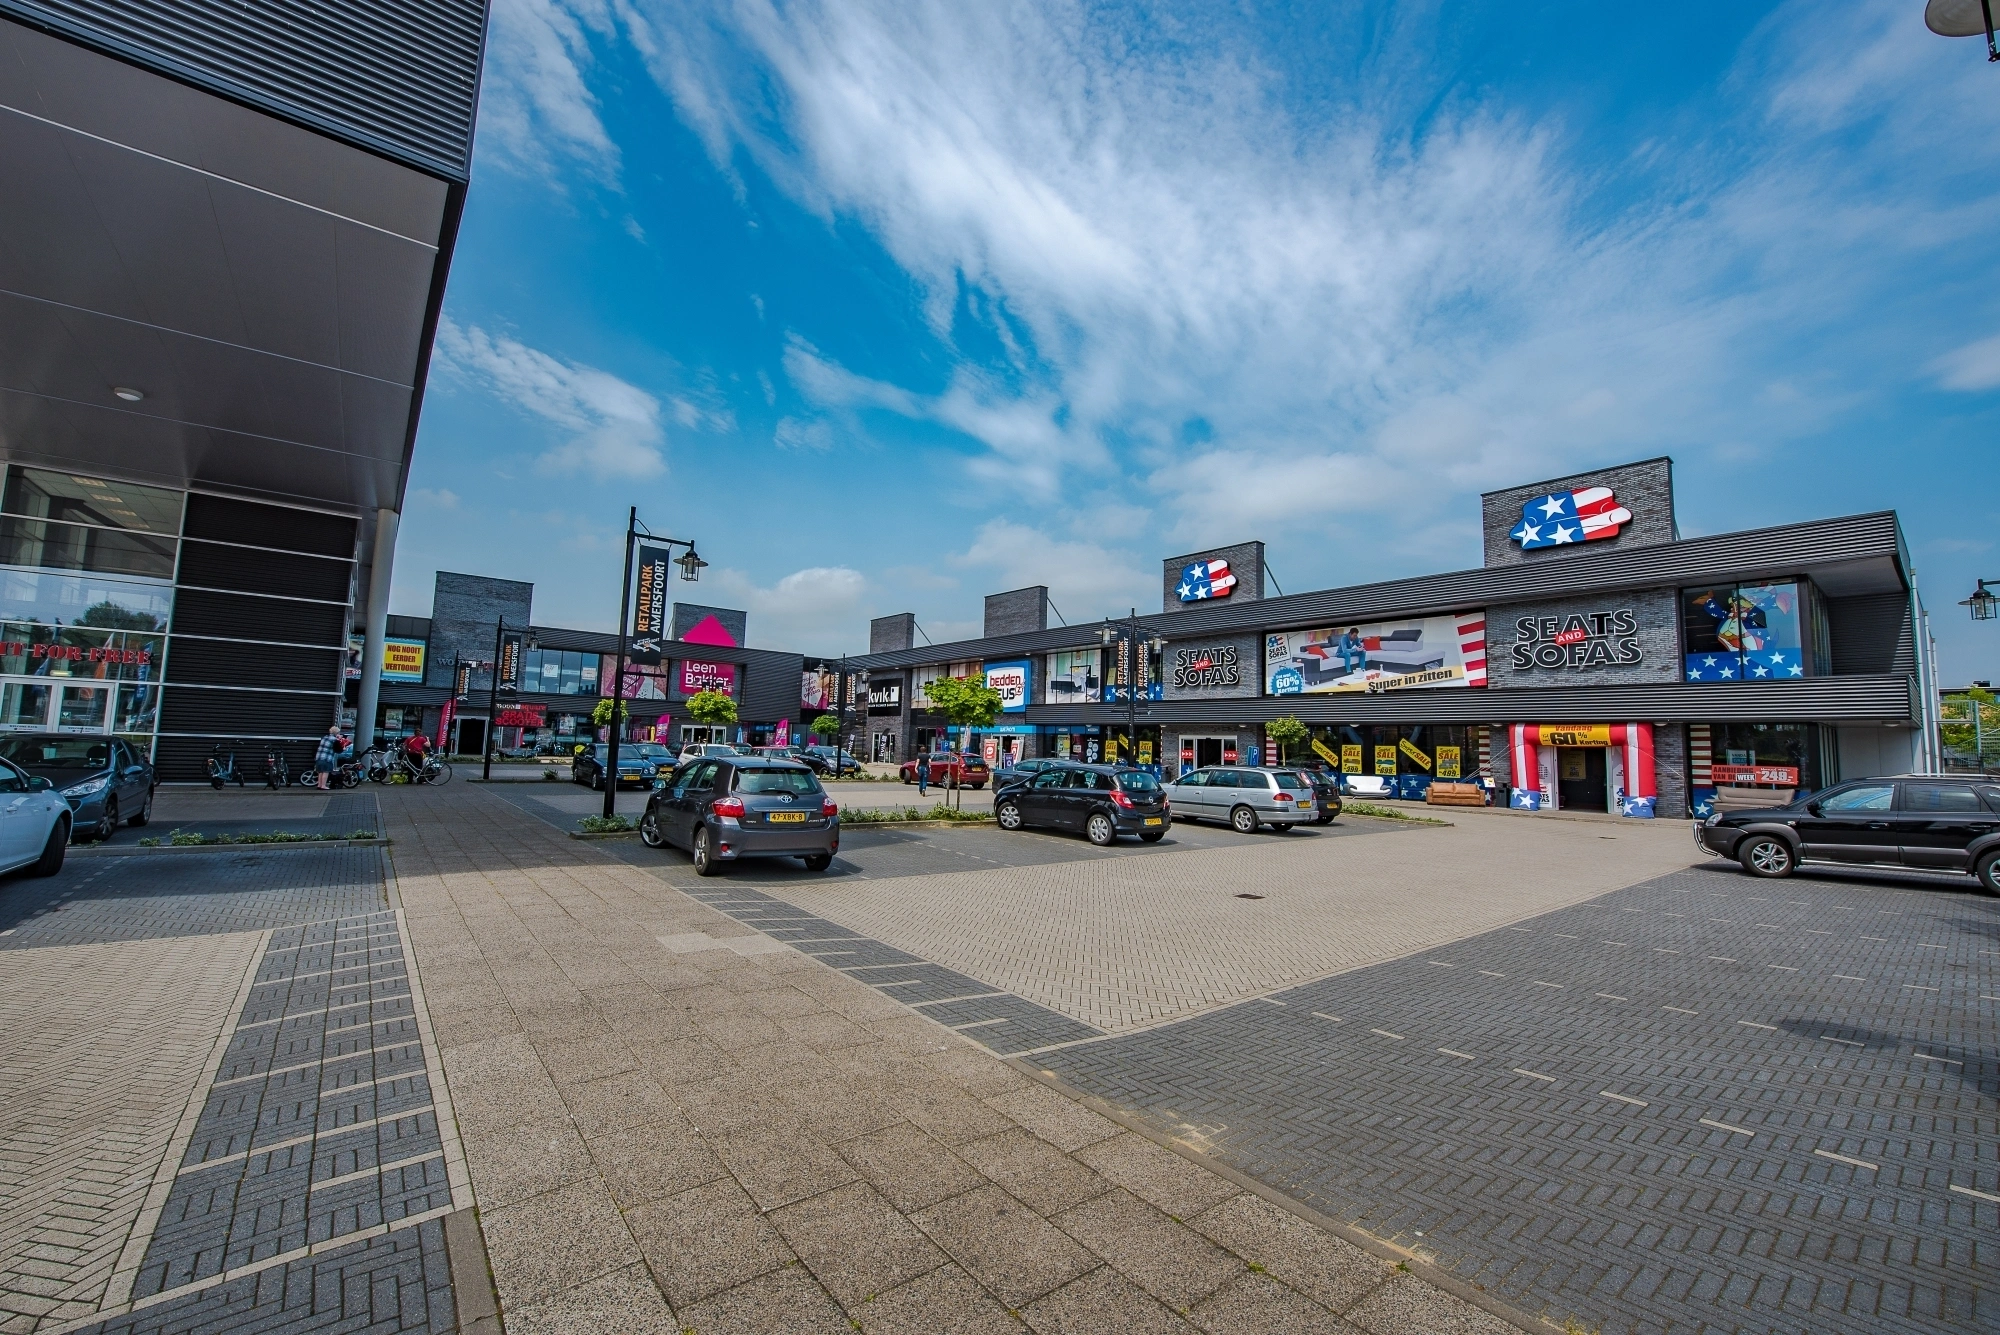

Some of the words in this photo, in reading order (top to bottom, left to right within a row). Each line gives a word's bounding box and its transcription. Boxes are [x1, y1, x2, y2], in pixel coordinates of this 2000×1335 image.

[638, 565, 653, 632] RETAILPARK
[650, 559, 665, 633] AMERSFOORT
[1516, 609, 1637, 643] SEATS
[1558, 631, 1582, 643] AND
[32, 643, 82, 661] FOR
[89, 647, 152, 665] FREE
[402, 646, 421, 654] NOOIT
[1268, 645, 1287, 655] SEATS
[1268, 650, 1288, 659] SOFAS
[1512, 637, 1643, 669] SOFAS
[392, 654, 416, 663] EERDER
[503, 644, 512, 680] RETAILPARK
[510, 641, 519, 680] AMERSFOORT
[1176, 646, 1237, 668] SEATS
[385, 663, 421, 672] VERTOOND!
[685, 661, 716, 674] Leen
[1195, 660, 1208, 669] AND
[685, 673, 729, 686] Bakker
[989, 674, 1021, 687] bedden
[1174, 666, 1239, 687] SOFAS
[1276, 675, 1299, 689] 60%
[1368, 677, 1403, 690] Super
[1404, 675, 1416, 685] in
[1418, 669, 1453, 683] zitten
[868, 686, 890, 703] kvik
[495, 717, 545, 726] SCOOTER
[502, 711, 538, 720] GRATIS
[1550, 732, 1578, 745] 60
[1325, 752, 1338, 764] SALE
[1414, 753, 1431, 766] SALE
[1438, 752, 1459, 760] SALE
[1713, 766, 1754, 774] AANBIEDING
